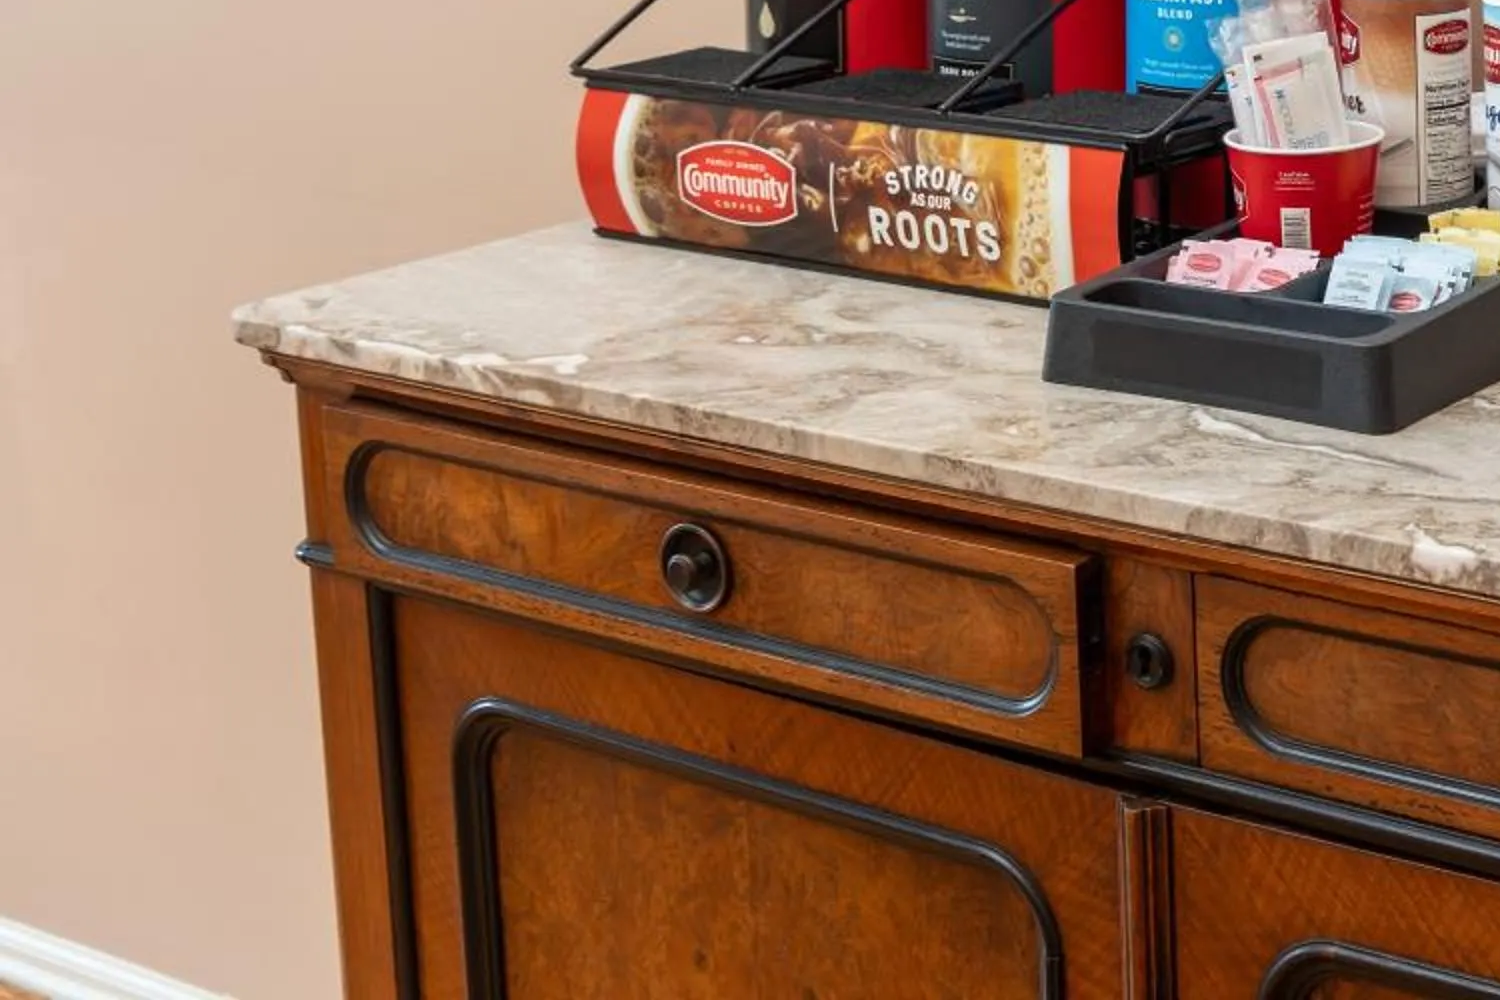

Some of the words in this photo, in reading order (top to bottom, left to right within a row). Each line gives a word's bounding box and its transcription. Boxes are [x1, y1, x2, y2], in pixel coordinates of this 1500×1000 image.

[1157, 7, 1193, 21] BLEND
[683, 163, 789, 209] Community
[884, 163, 979, 205] STRONG
[713, 200, 762, 213] COFFEE
[910, 192, 925, 207] AS
[927, 195, 951, 210] OUR
[868, 205, 1001, 261] ROOTS
